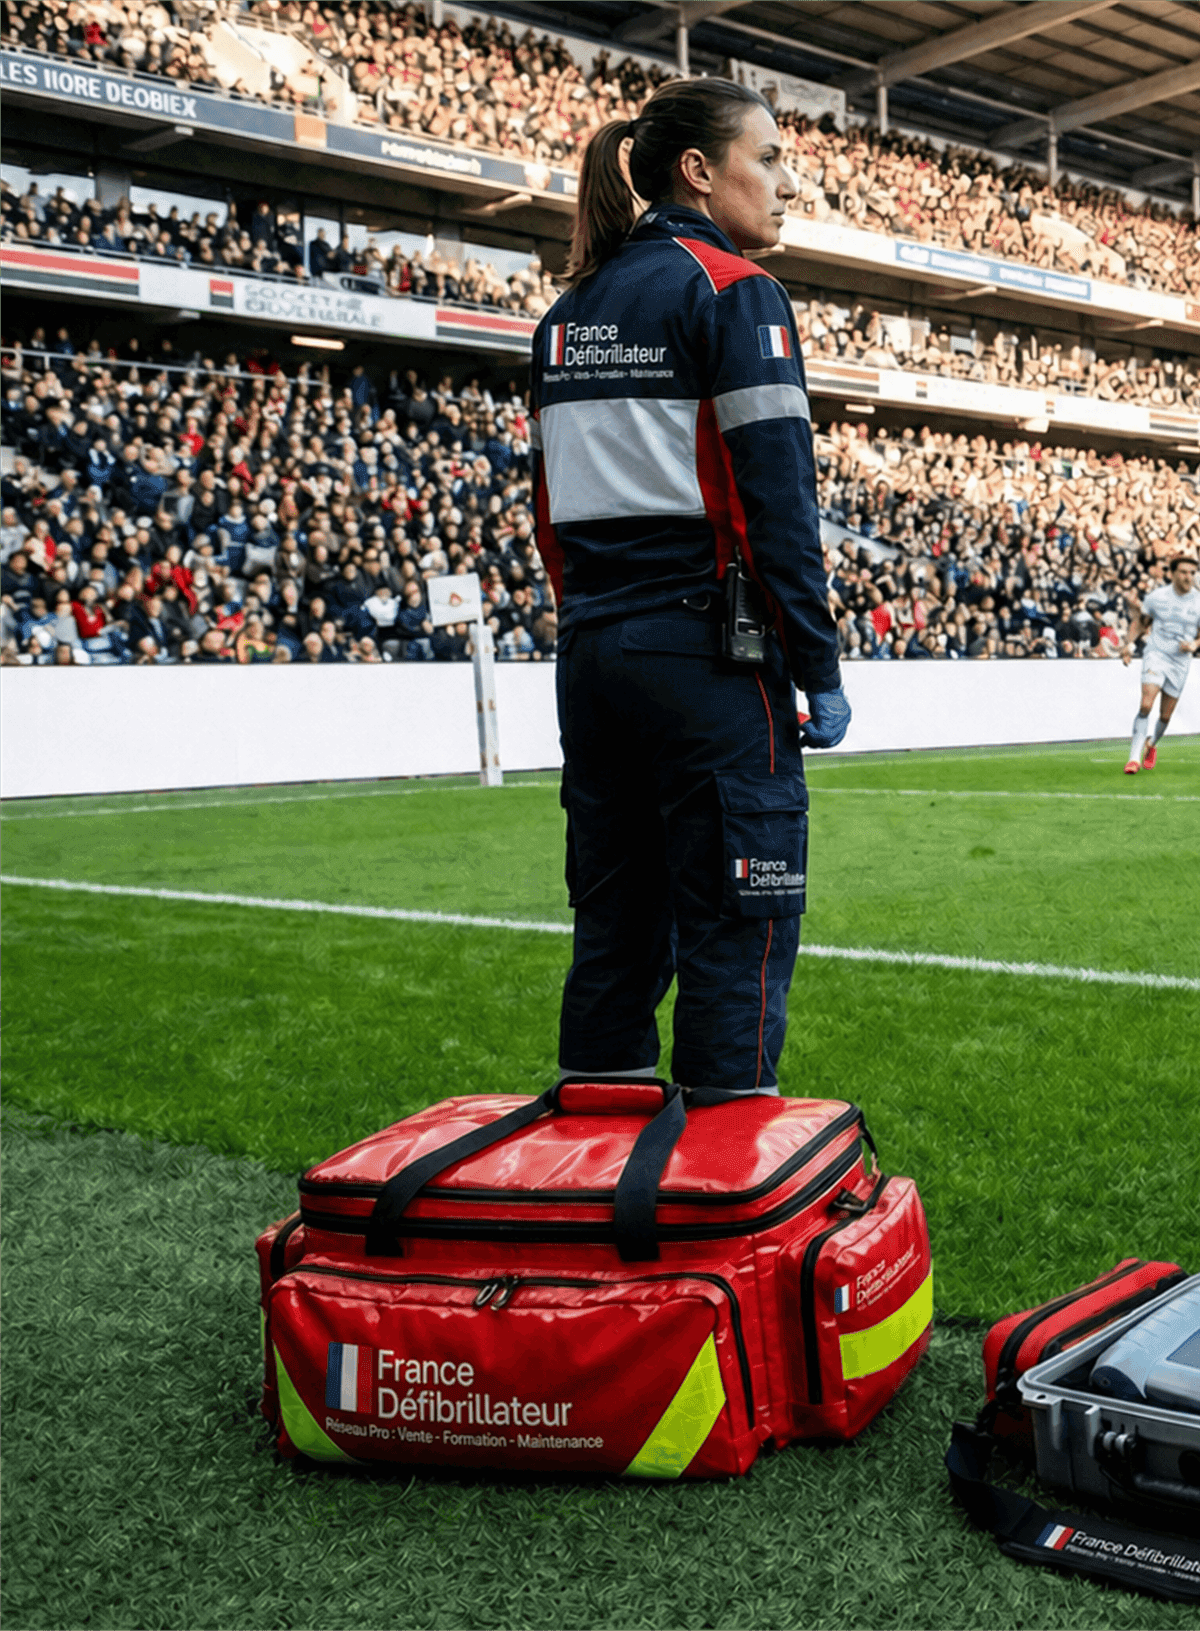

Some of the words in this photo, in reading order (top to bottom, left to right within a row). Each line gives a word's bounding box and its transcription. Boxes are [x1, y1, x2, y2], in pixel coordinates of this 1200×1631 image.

[566, 322, 618, 342] France
[565, 343, 667, 366] Défibrillateur
[378, 1349, 474, 1387] France
[378, 1387, 573, 1426] Défibrillateur
[325, 1417, 368, 1437] Réseau
[398, 1426, 433, 1443] Vente
[443, 1431, 507, 1447] Formation
[517, 1434, 604, 1449] Maintenance
[1070, 1531, 1124, 1554] France
